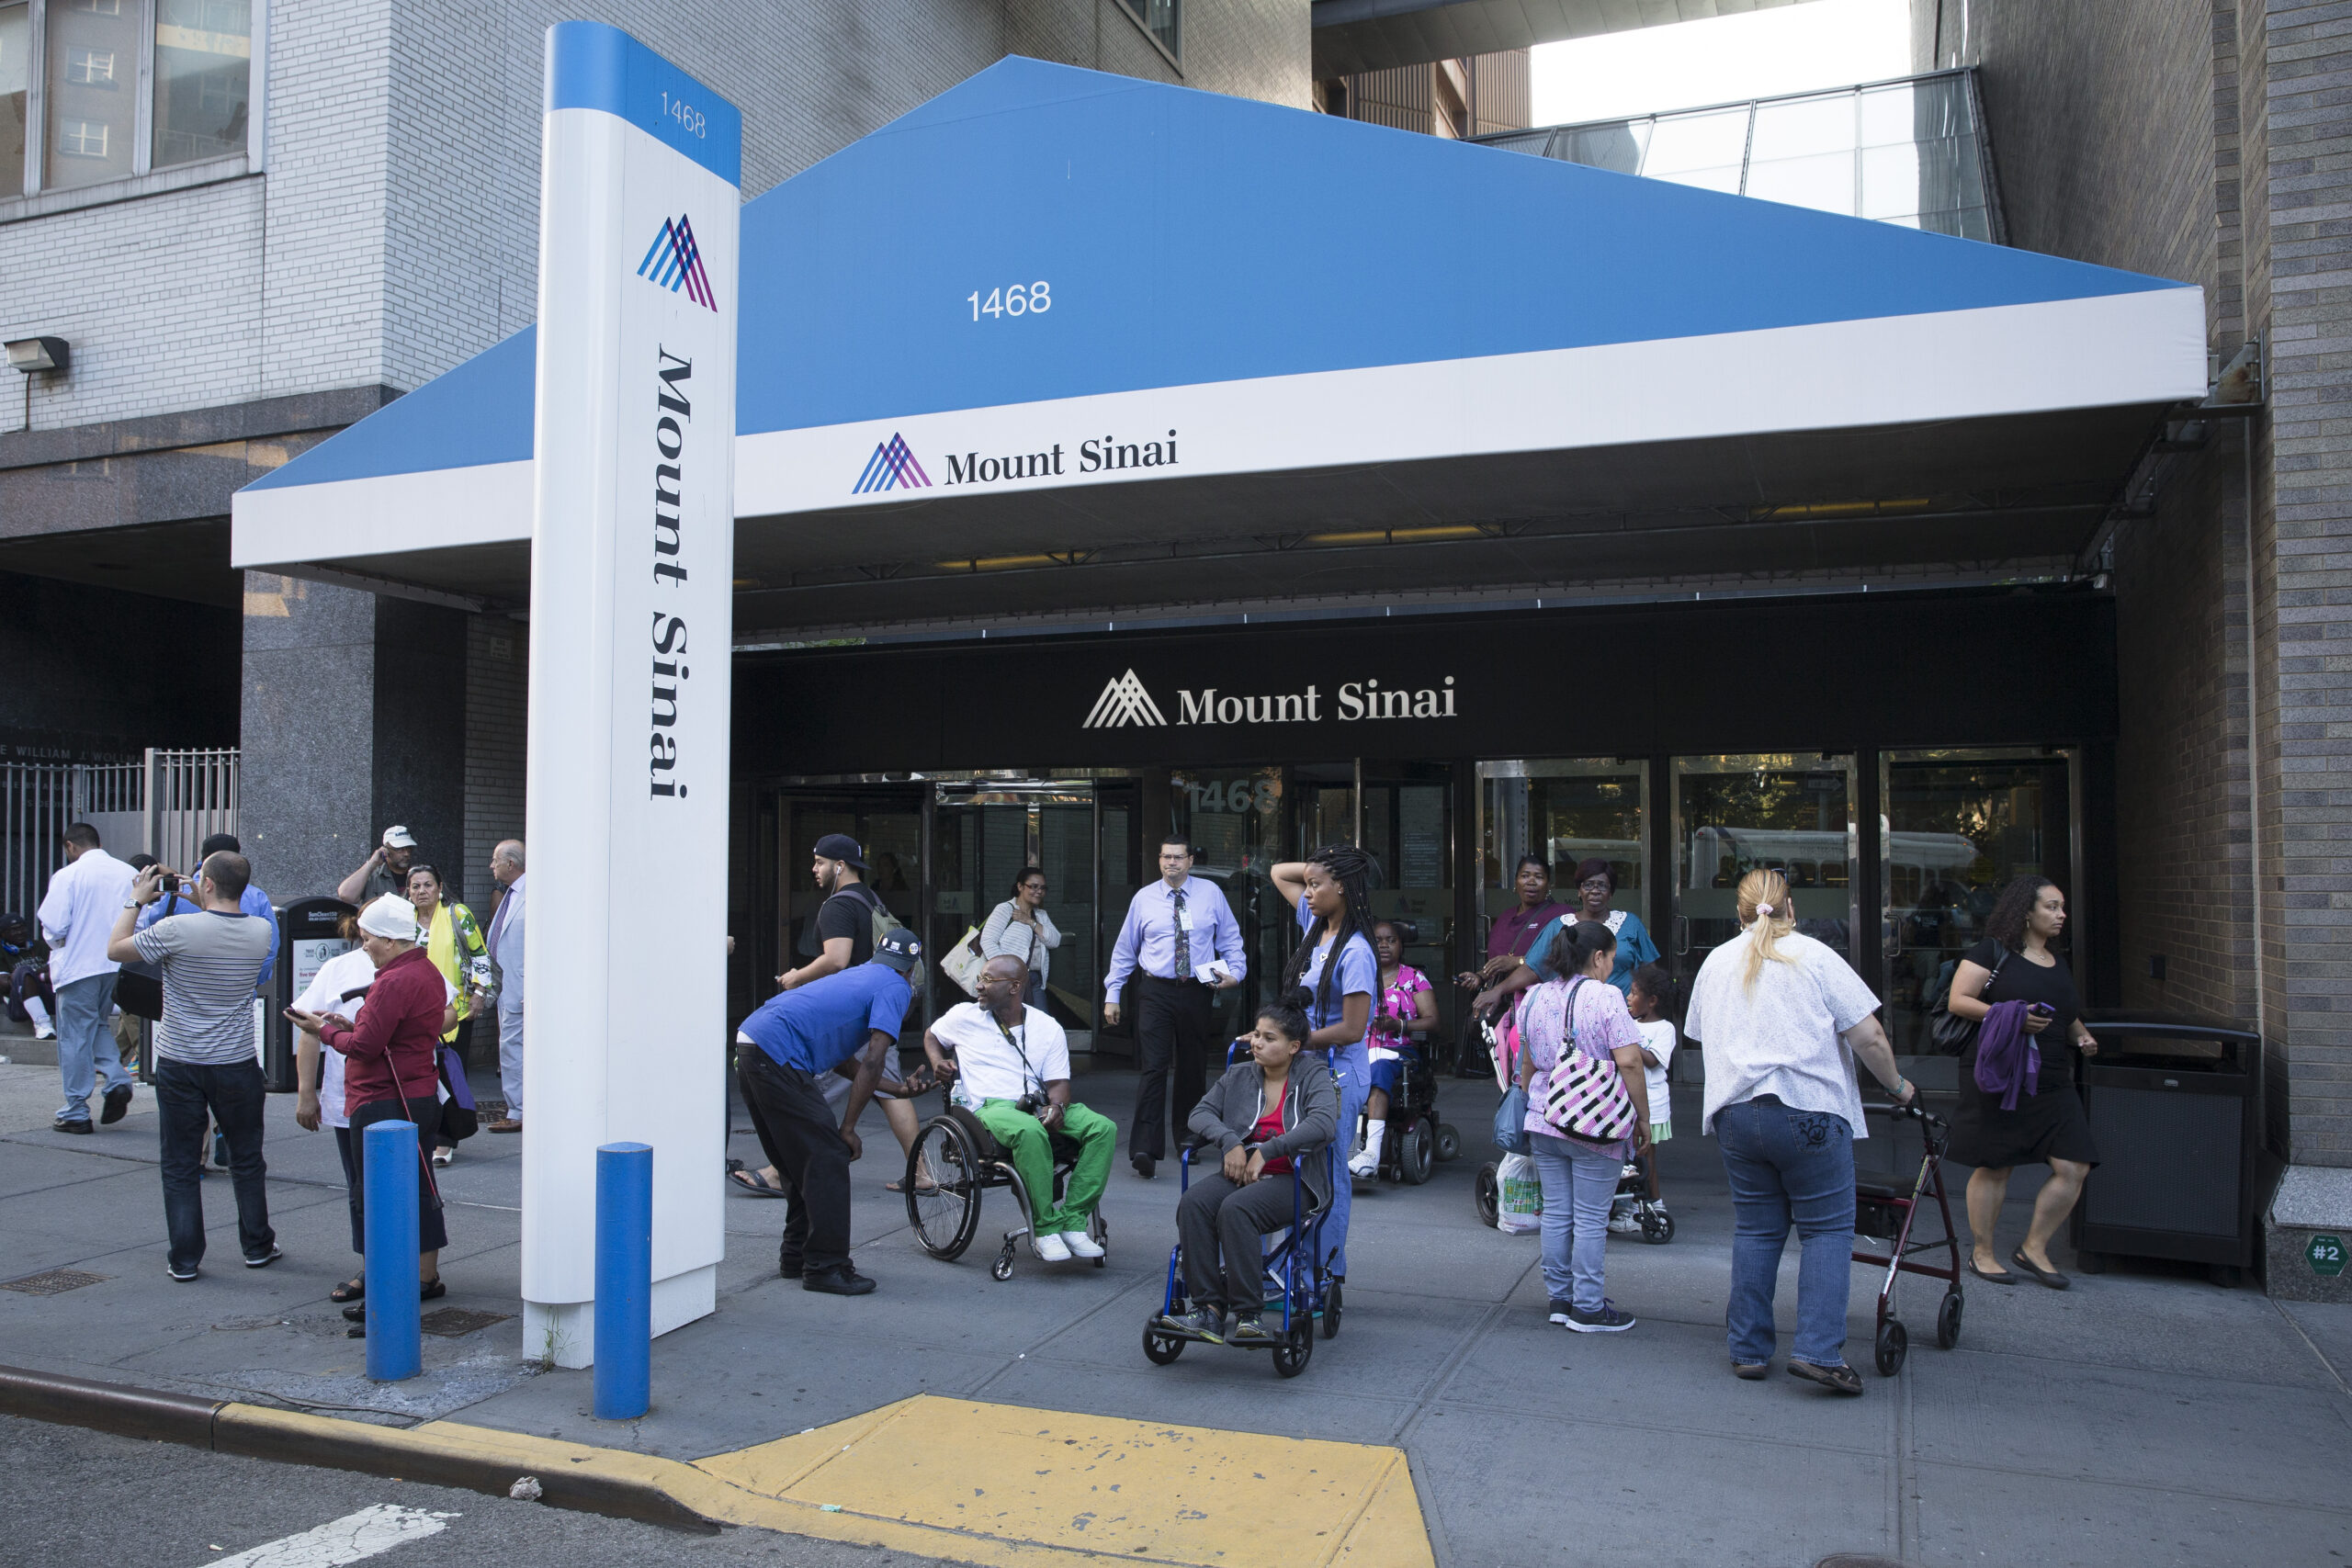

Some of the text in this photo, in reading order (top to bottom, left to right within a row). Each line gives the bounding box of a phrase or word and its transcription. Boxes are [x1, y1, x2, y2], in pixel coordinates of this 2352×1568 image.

[662, 91, 706, 139] 1468
[967, 281, 1052, 321] 1468
[944, 429, 1180, 486] Mount Sinai
[650, 344, 692, 800] Mount Sinai
[1176, 676, 1457, 726] Mount Sinai
[16, 745, 71, 760] WILLIAM
[1189, 779, 1280, 814] 1468
[2312, 1245, 2340, 1261] #2
